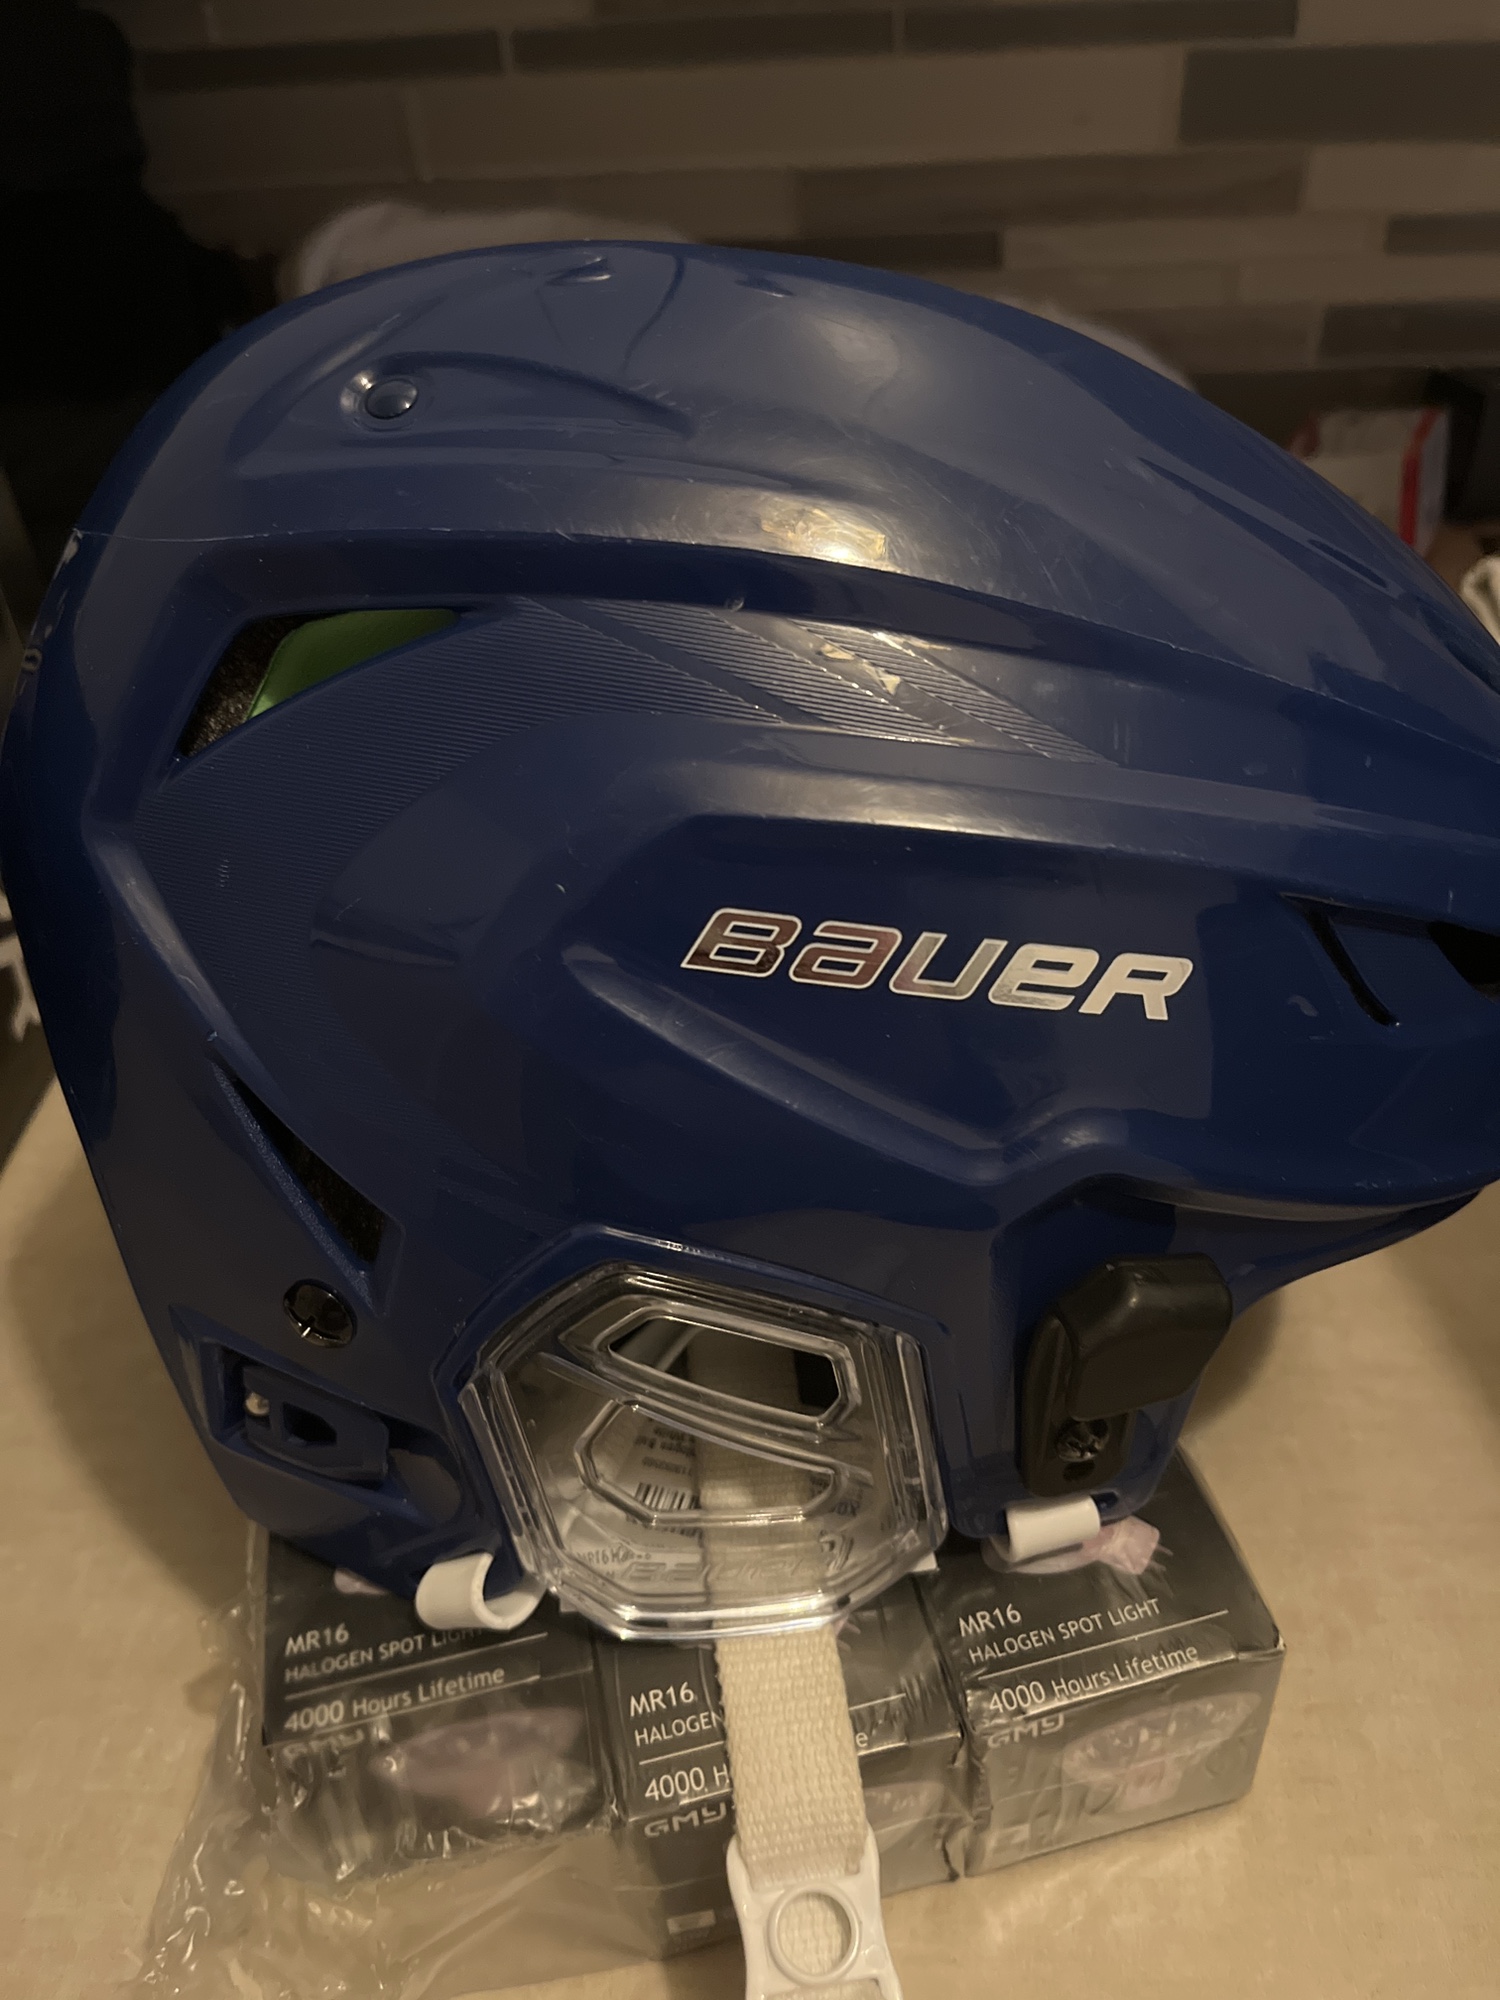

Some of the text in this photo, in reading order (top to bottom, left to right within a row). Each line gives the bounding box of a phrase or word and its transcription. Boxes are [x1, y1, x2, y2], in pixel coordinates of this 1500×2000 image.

[680, 906, 1194, 1020] BAUER
[958, 1603, 1022, 1638] MR16
[968, 1598, 1161, 1665] HALOGEN SPOT LIGHT
[284, 1622, 350, 1657] MR16
[284, 1647, 374, 1684] HALOGEN
[378, 1634, 426, 1661] SPOT
[989, 1646, 1199, 1713] 4000 Hours Lifetime
[283, 1667, 506, 1732] 4000 Hours Lifetime
[629, 1681, 695, 1718] MR16
[634, 1711, 725, 1747] HALOGEN
[644, 1767, 706, 1801] 4000
[643, 1801, 728, 1838] GMY
